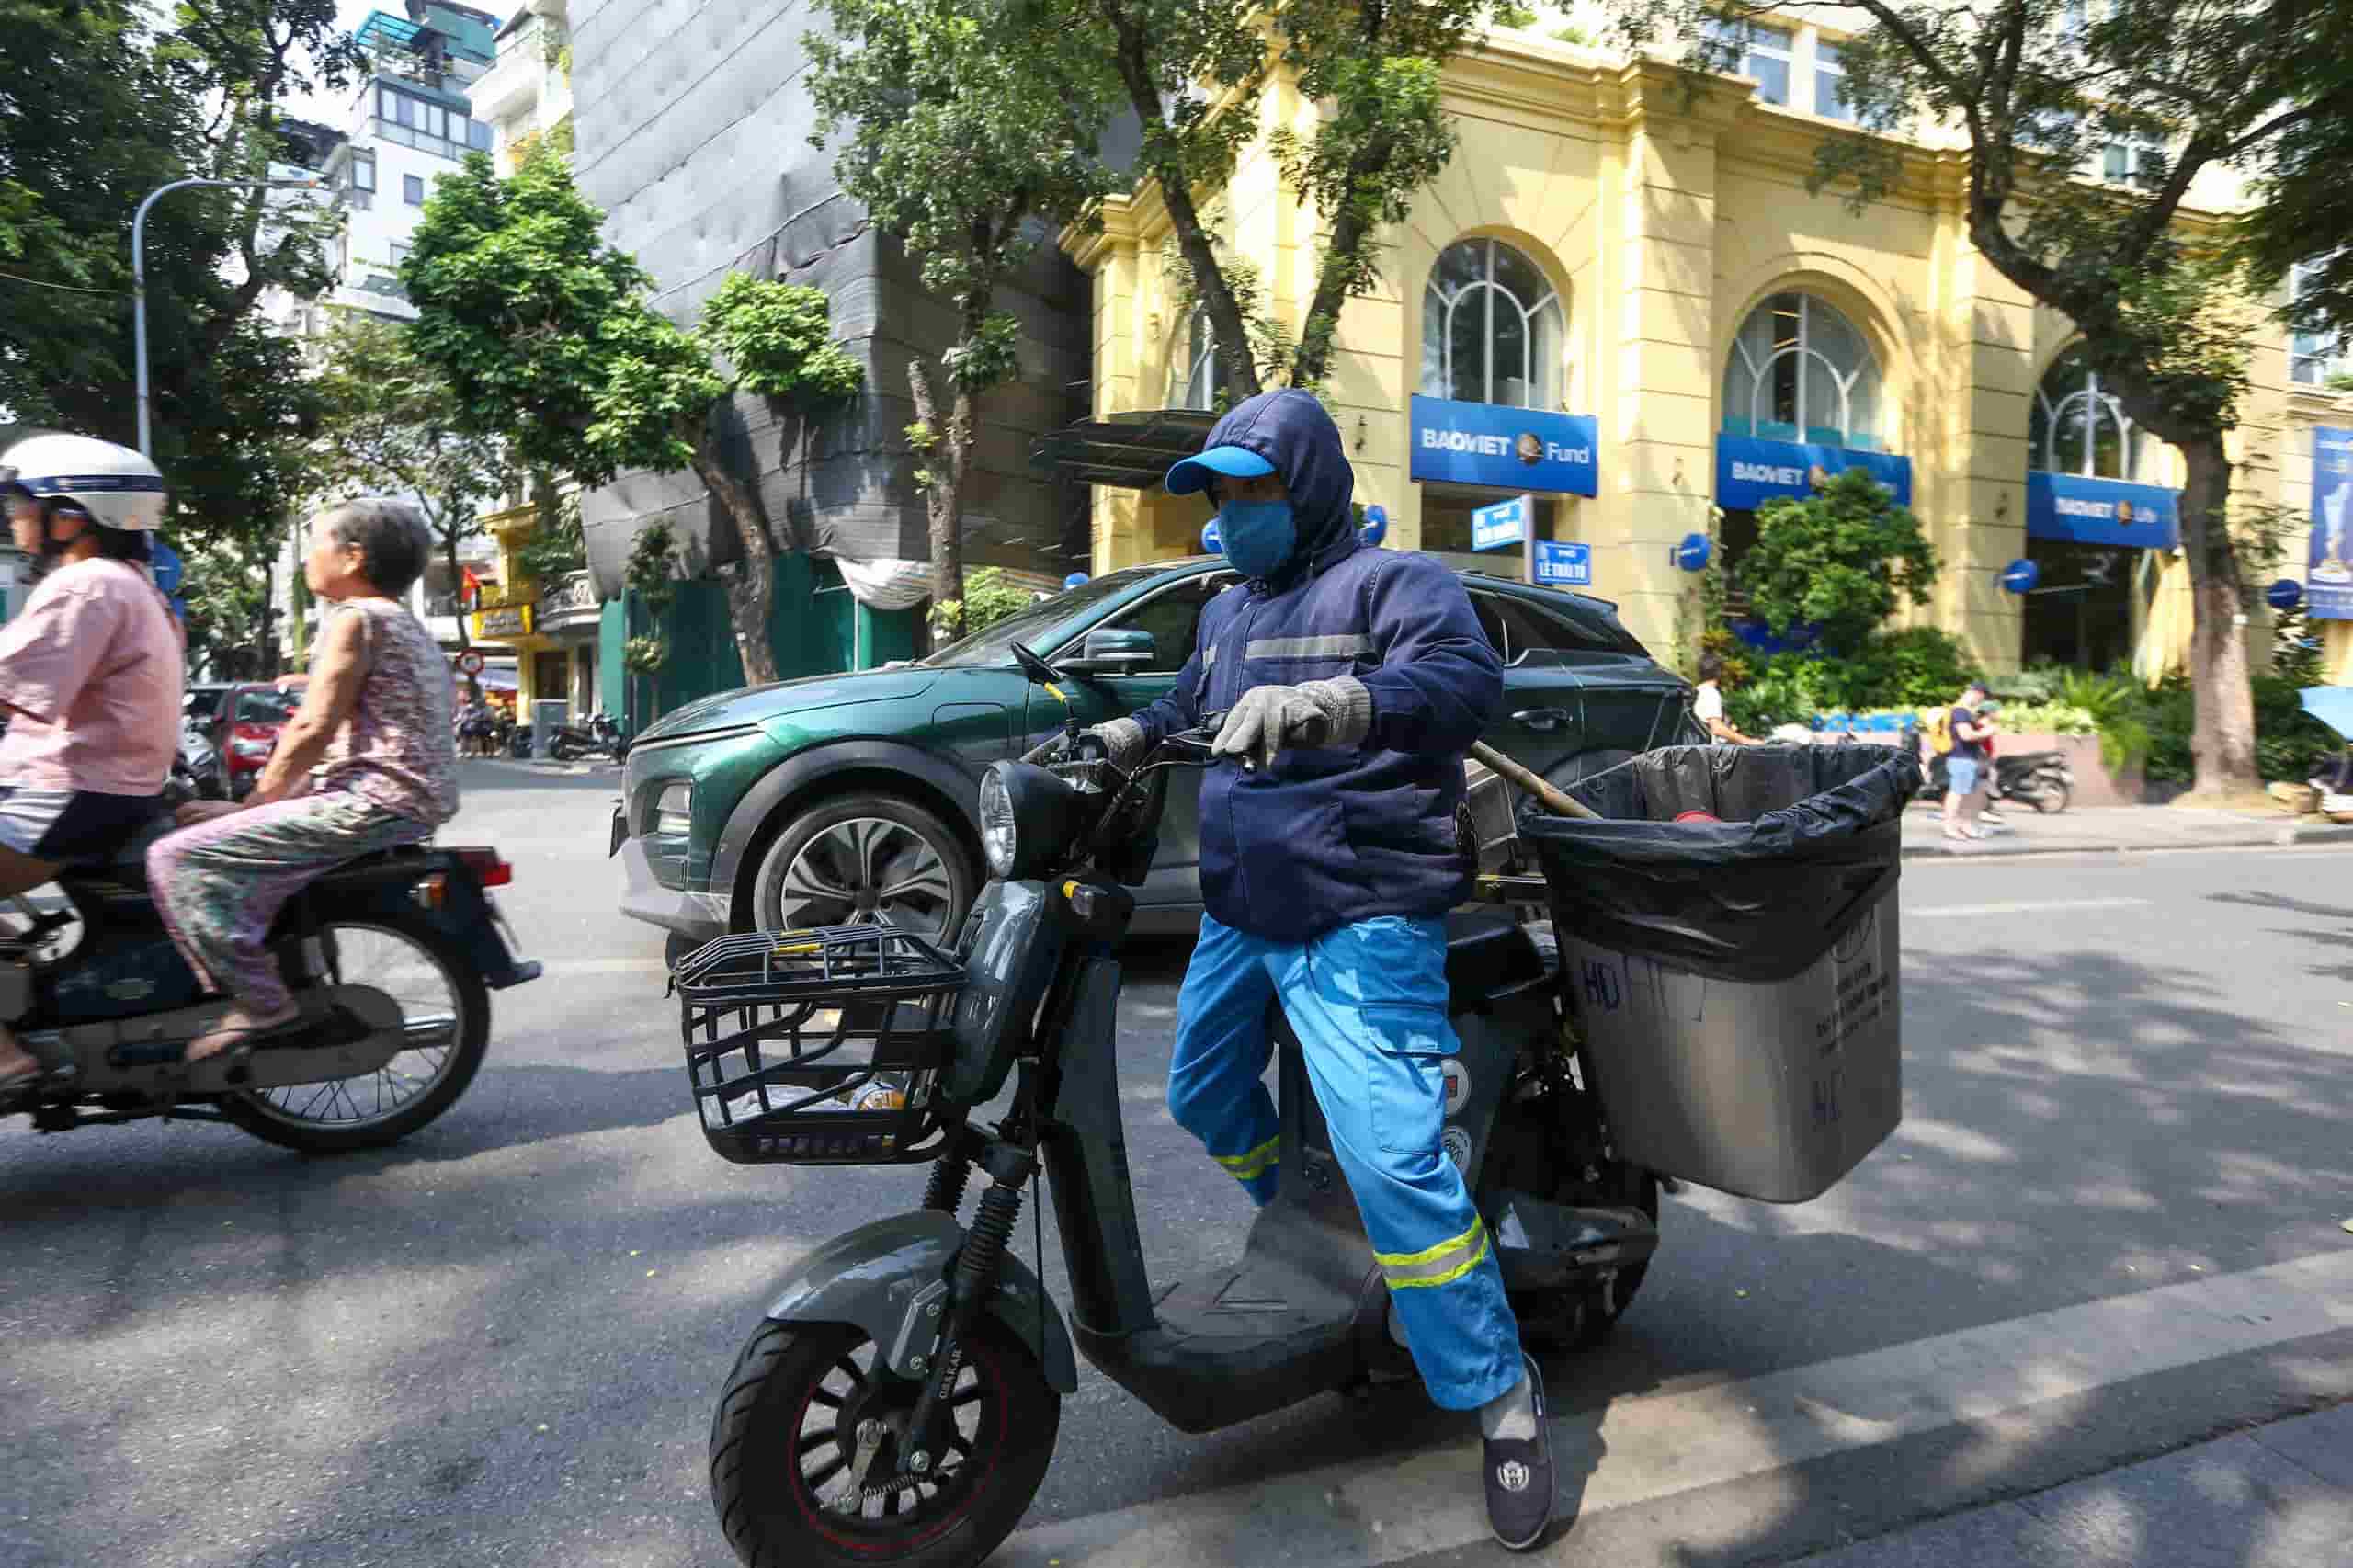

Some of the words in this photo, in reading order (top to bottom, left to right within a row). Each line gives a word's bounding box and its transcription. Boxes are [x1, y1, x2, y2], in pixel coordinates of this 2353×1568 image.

[1421, 427, 1510, 456] BAOVIET
[1547, 442, 1589, 464] Fund
[1733, 461, 1805, 486] BAOVIET
